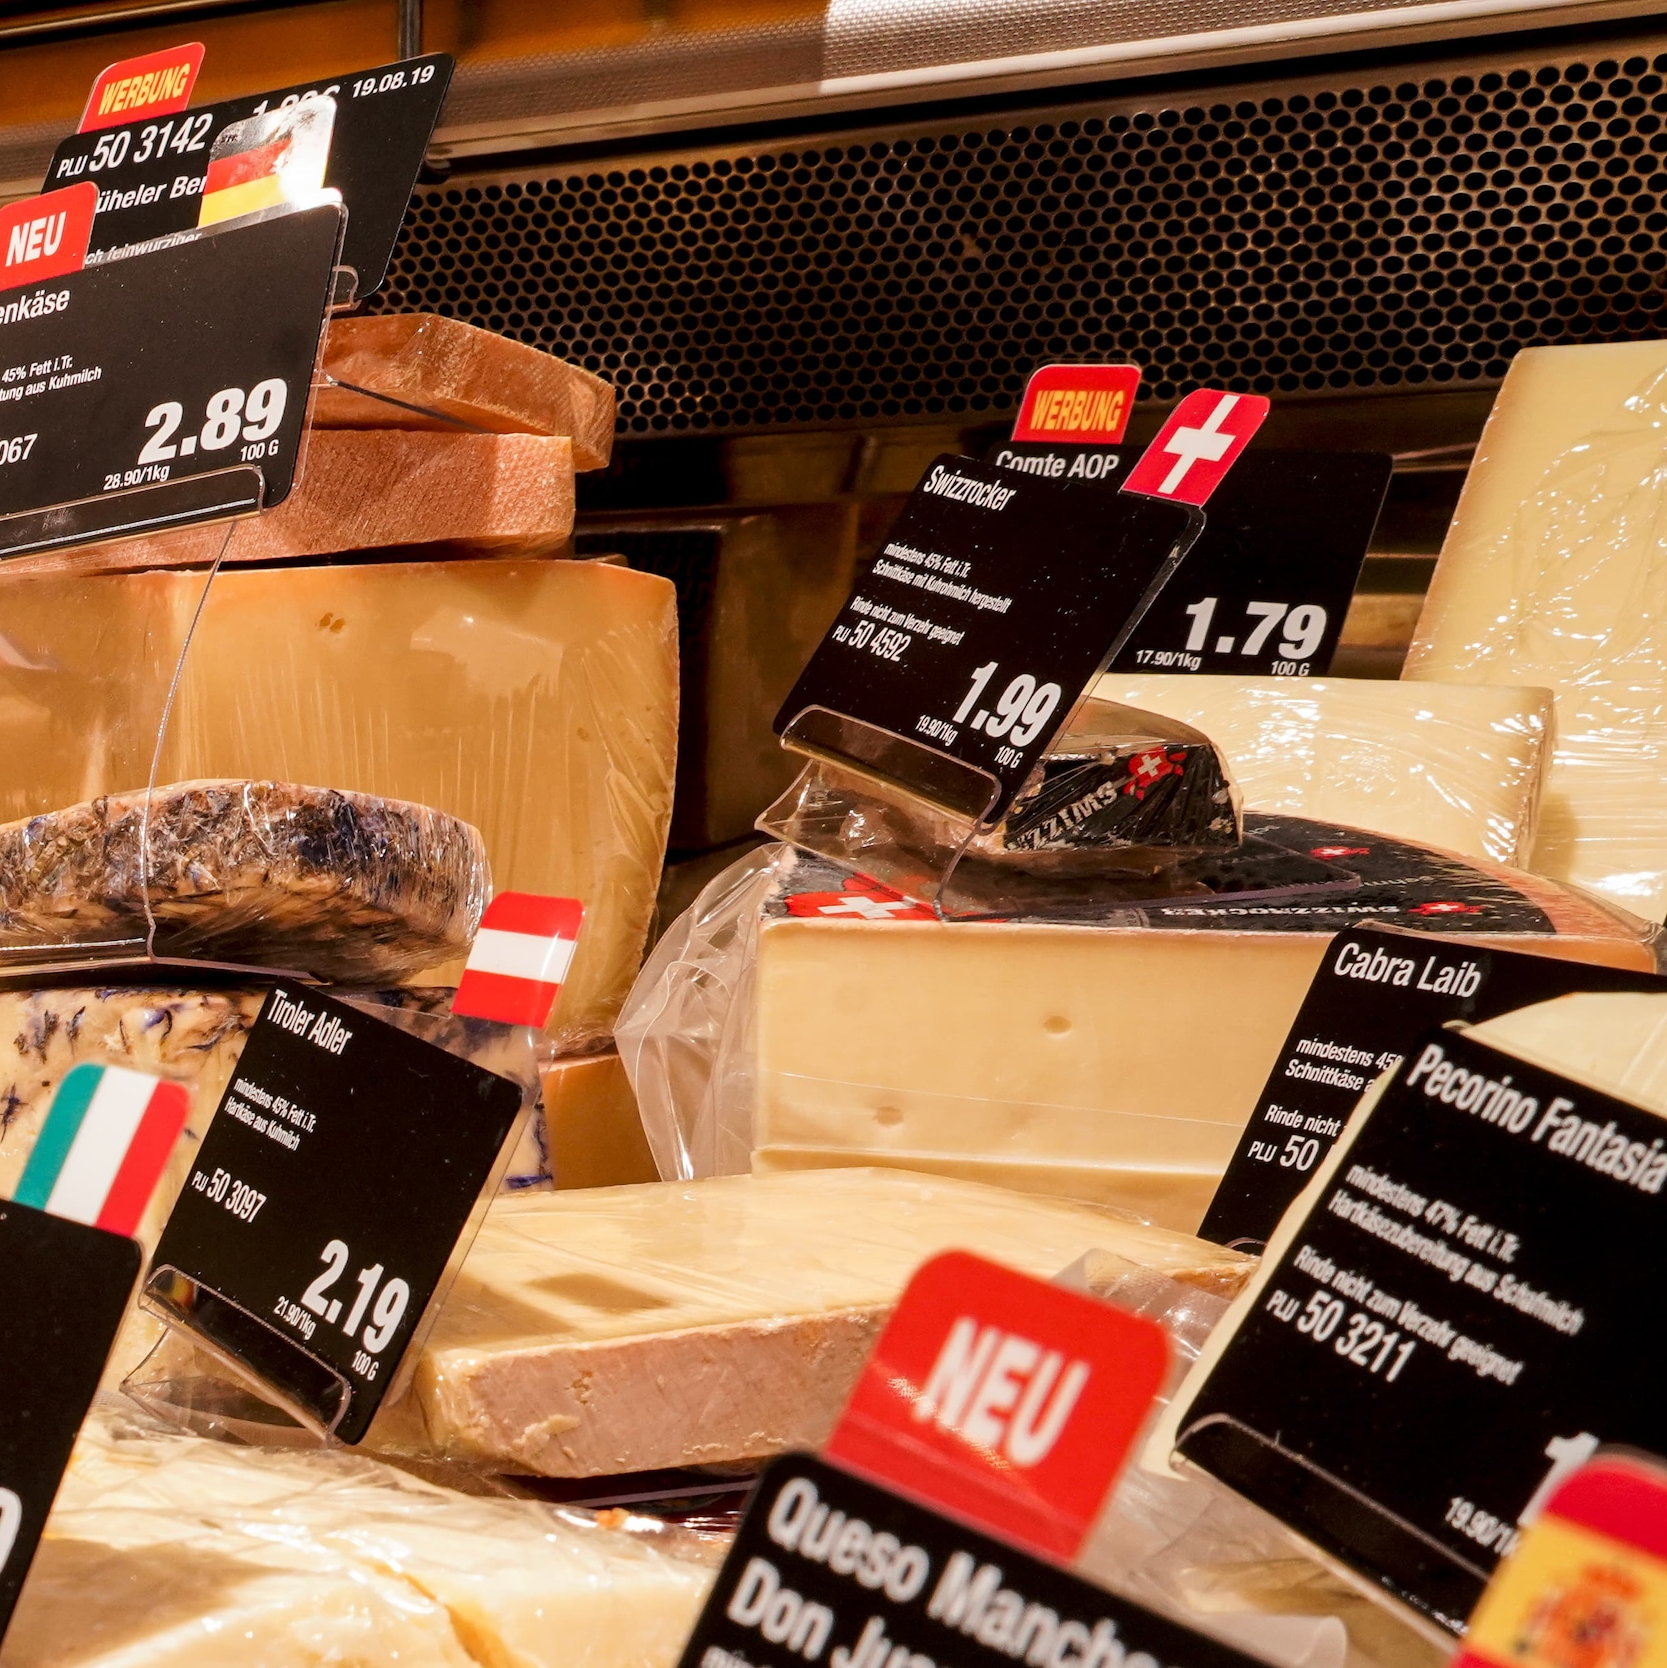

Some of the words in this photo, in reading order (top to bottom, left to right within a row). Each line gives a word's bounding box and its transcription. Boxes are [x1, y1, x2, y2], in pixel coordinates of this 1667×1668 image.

[96, 62, 192, 117] WERBUNG
[351, 63, 435, 98] 19.08.19
[57, 153, 88, 180] PLU
[88, 132, 132, 173] 50
[132, 112, 215, 165] 3142
[4, 211, 67, 268] NEU
[0, 364, 27, 383] 45%
[27, 358, 53, 377] Fett
[52, 353, 73, 372] i.Tr.
[136, 377, 288, 466] 2.89
[1028, 388, 1126, 433] WERBUNG
[922, 463, 1017, 511] Swizzrocker
[994, 449, 1066, 478] Comte
[1065, 452, 1120, 479] AOP
[1184, 596, 1327, 660] 1.79
[951, 660, 1062, 748] 1.99
[1333, 941, 1416, 987] Cabra
[1415, 954, 1482, 998] Laib
[266, 987, 316, 1037] Tiroler
[306, 1010, 353, 1056] Adler
[1405, 1042, 1538, 1134] Pecorino
[1530, 1096, 1667, 1192] Fantasia
[190, 1169, 210, 1192] PLU
[205, 1166, 231, 1203] 50
[223, 1178, 267, 1223] 3097
[299, 1238, 410, 1354] 2.19
[911, 1317, 1089, 1468] NEU
[766, 1477, 930, 1602] Queso
[726, 1556, 834, 1660] Don
